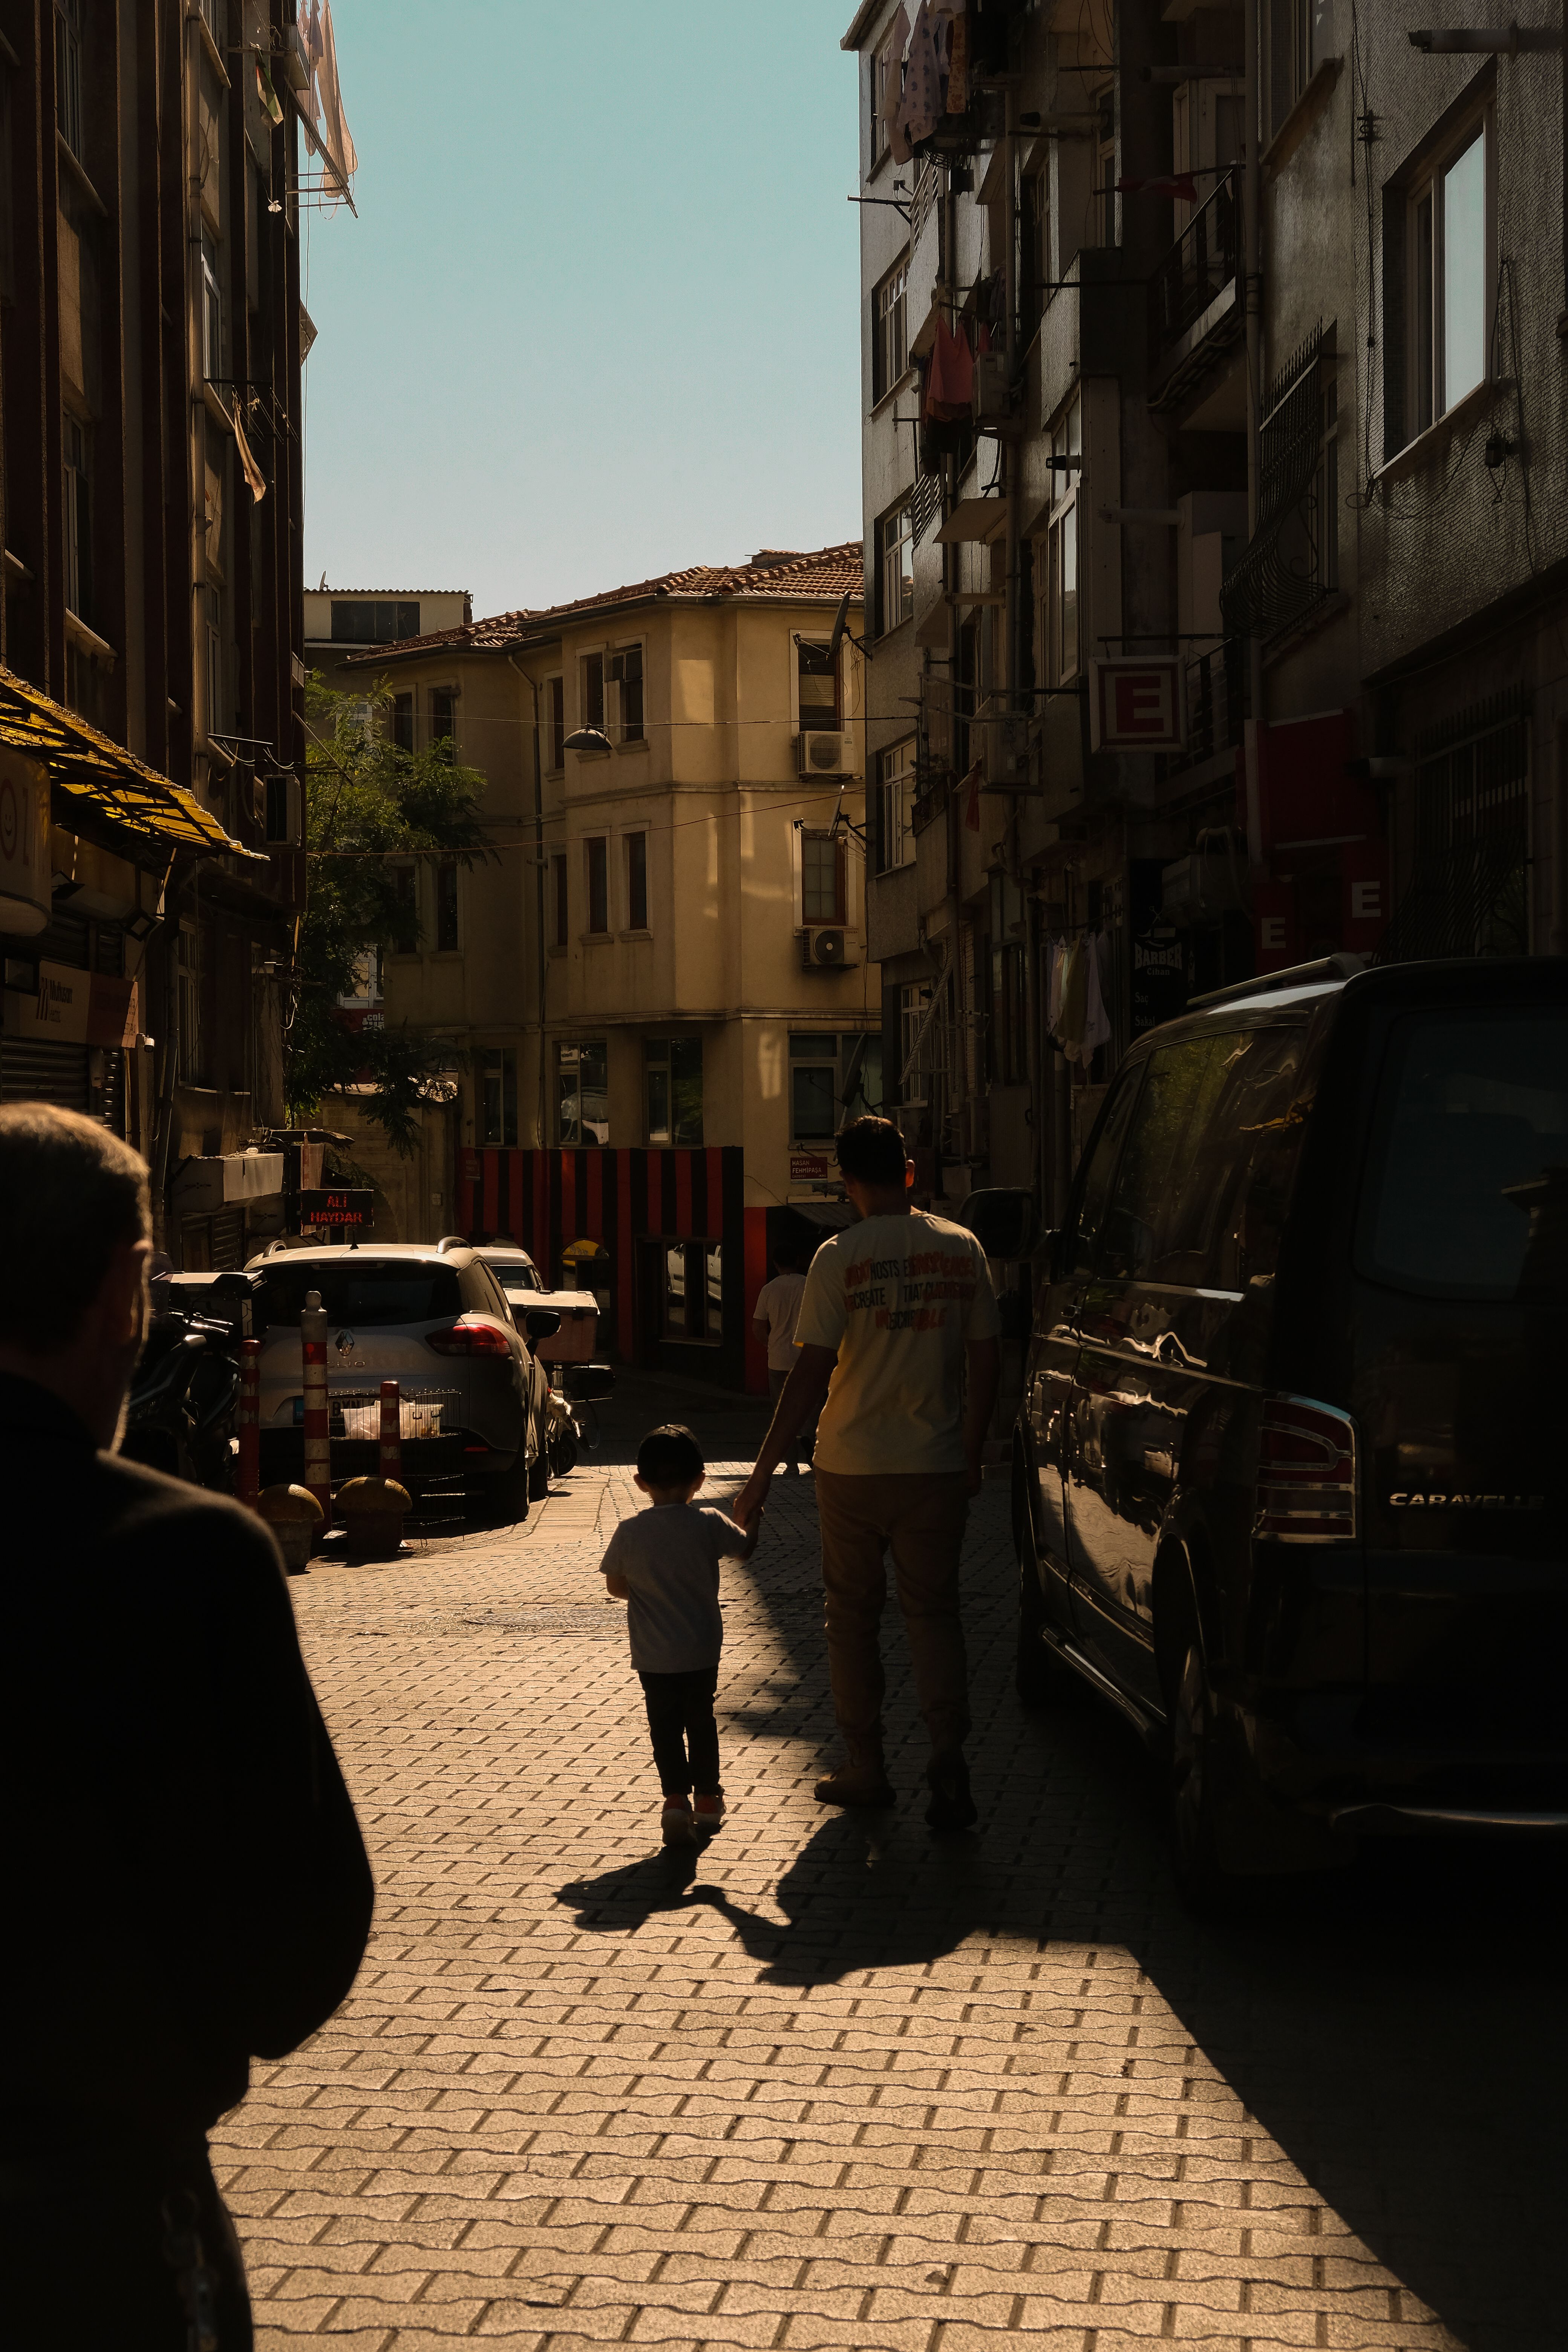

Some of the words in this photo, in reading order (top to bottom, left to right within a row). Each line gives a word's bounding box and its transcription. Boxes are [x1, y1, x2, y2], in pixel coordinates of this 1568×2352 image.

[1115, 675, 1164, 732] E
[1352, 881, 1381, 918] E
[1261, 917, 1286, 949] E
[1135, 942, 1182, 971] BARBER
[1135, 992, 1149, 1006] Saç
[1135, 1015, 1155, 1027] Sakal
[327, 1193, 347, 1208] ALİ
[311, 1211, 362, 1223] HAYDAR
[870, 1259, 899, 1281] HOSTS
[1389, 1493, 1544, 1510] CARAVELLE
